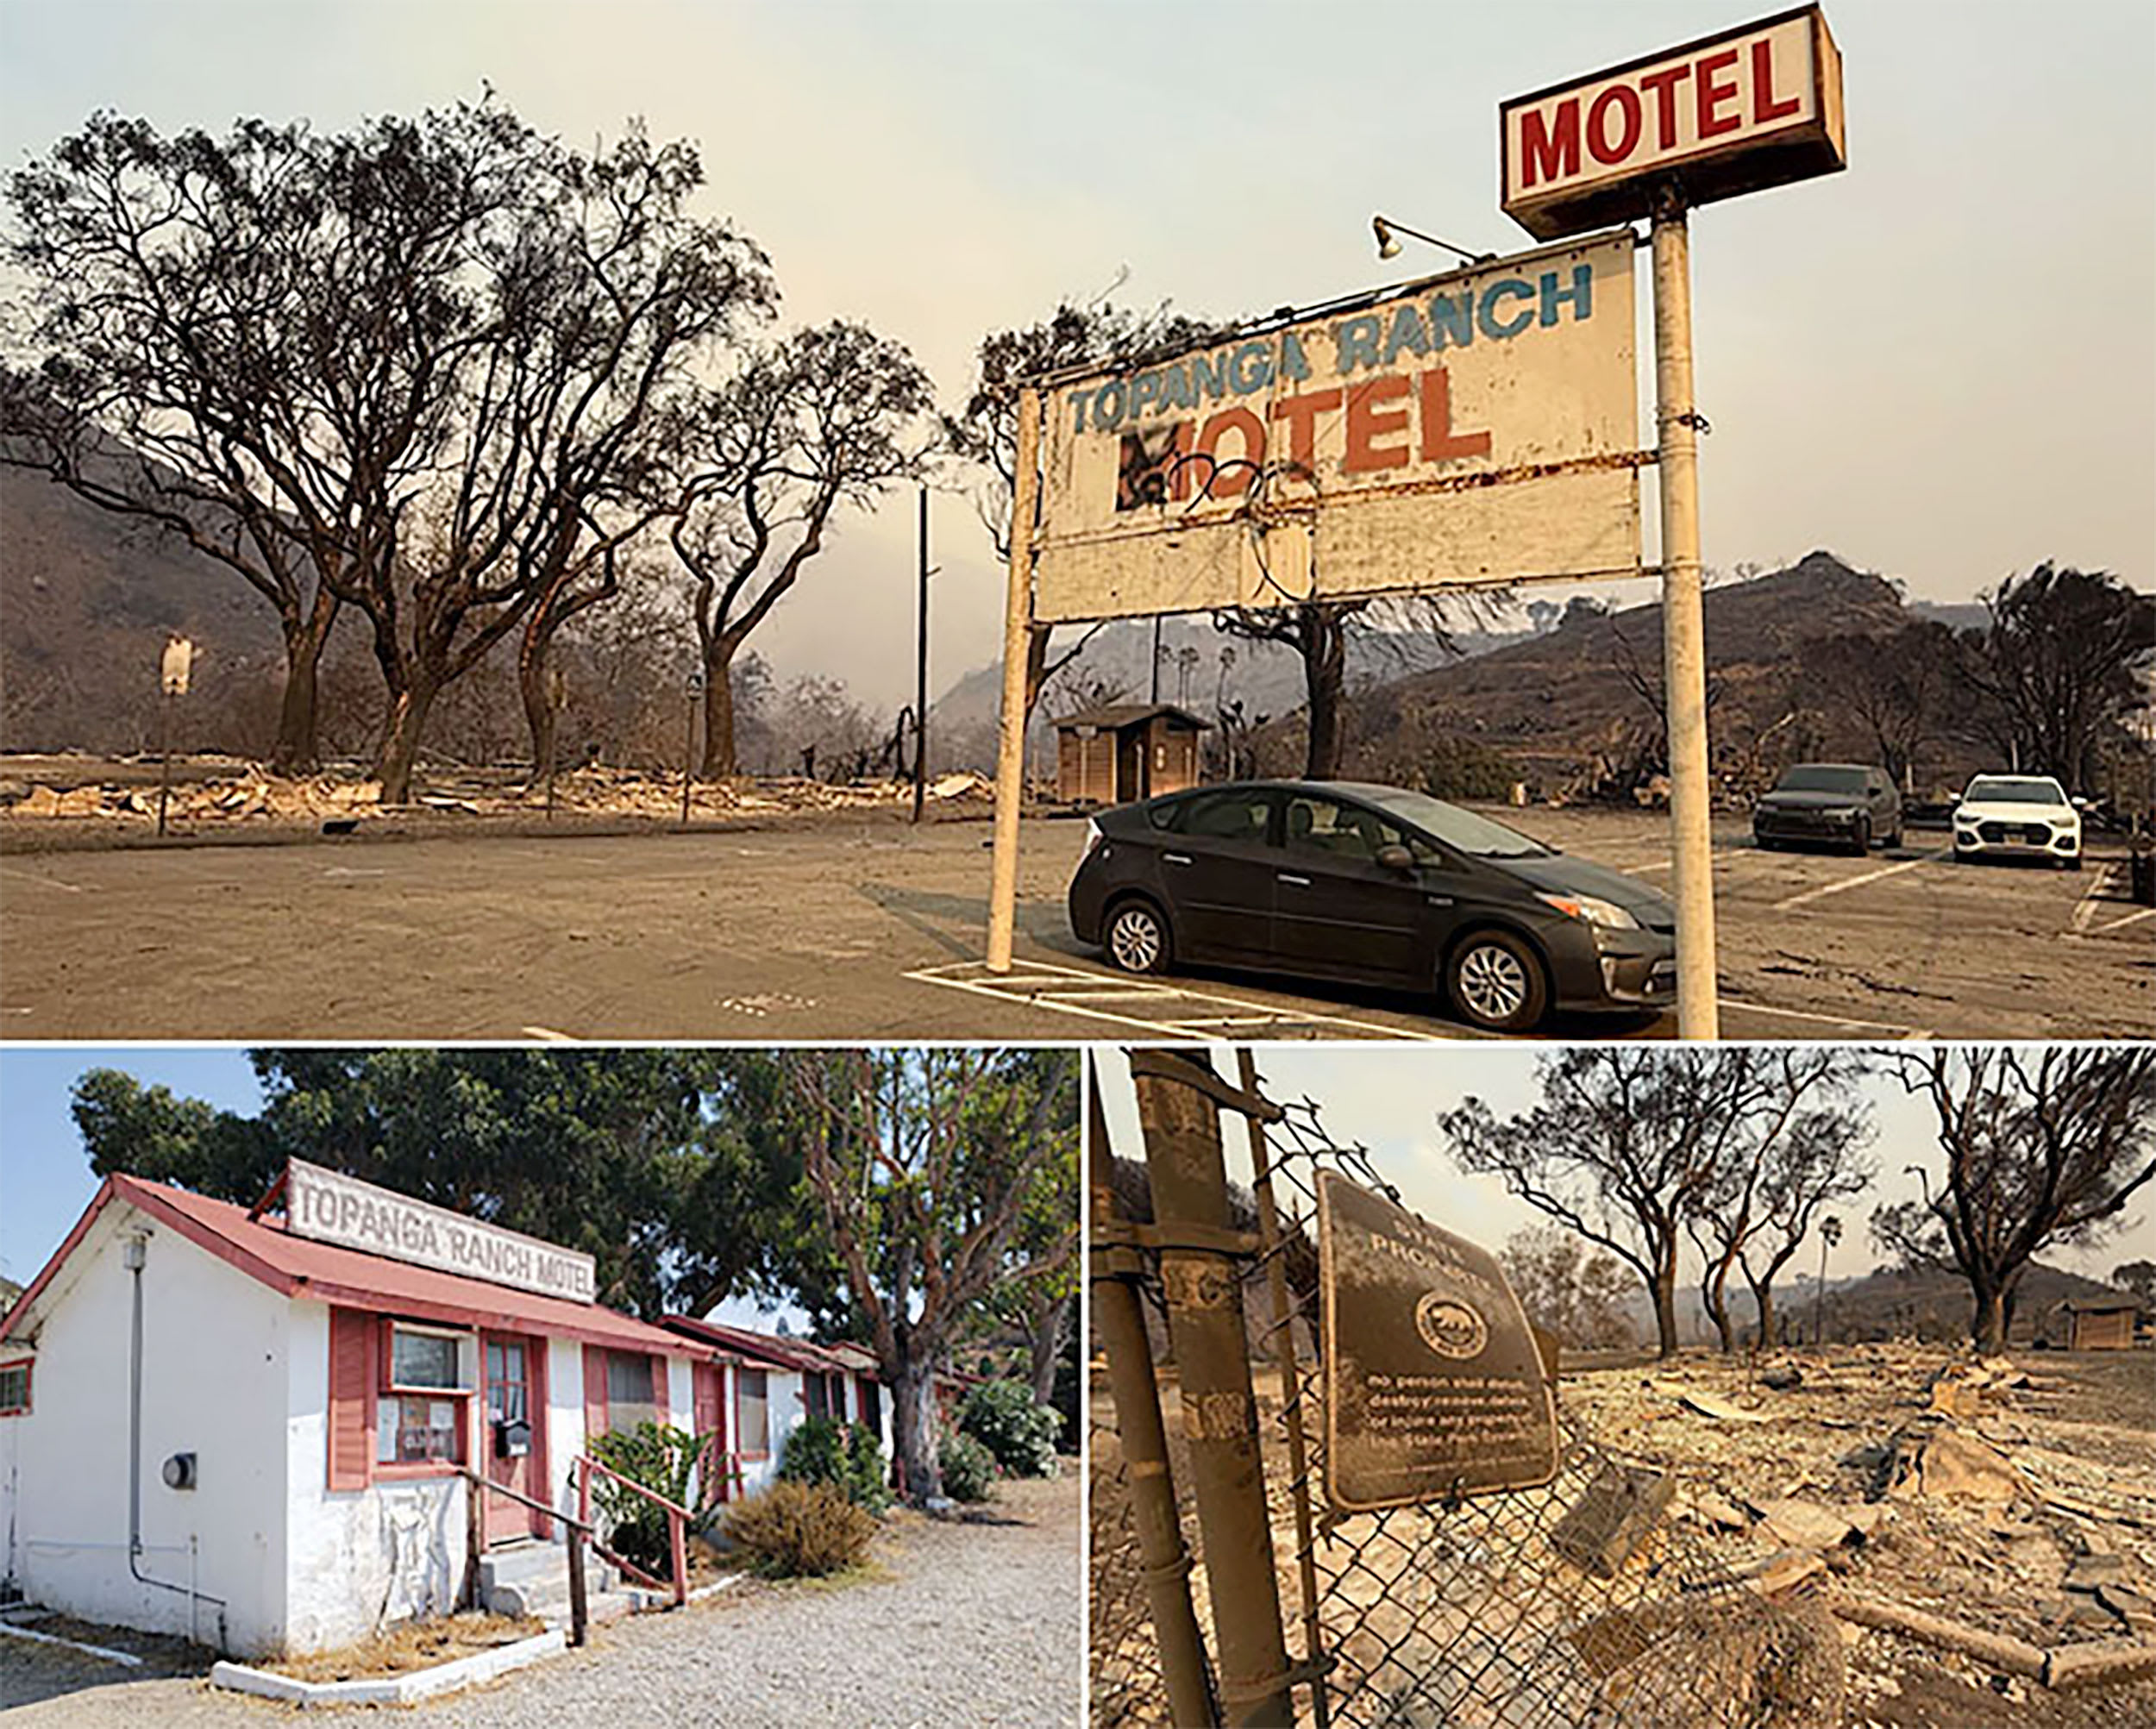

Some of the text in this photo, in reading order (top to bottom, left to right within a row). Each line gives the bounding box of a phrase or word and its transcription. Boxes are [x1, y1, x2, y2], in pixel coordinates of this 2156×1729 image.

[1520, 39, 1800, 188] MOTEL
[1068, 264, 1592, 434] TOPANGA RANCH
[298, 1181, 593, 1294] TOPANGA RANCH MOTEL
